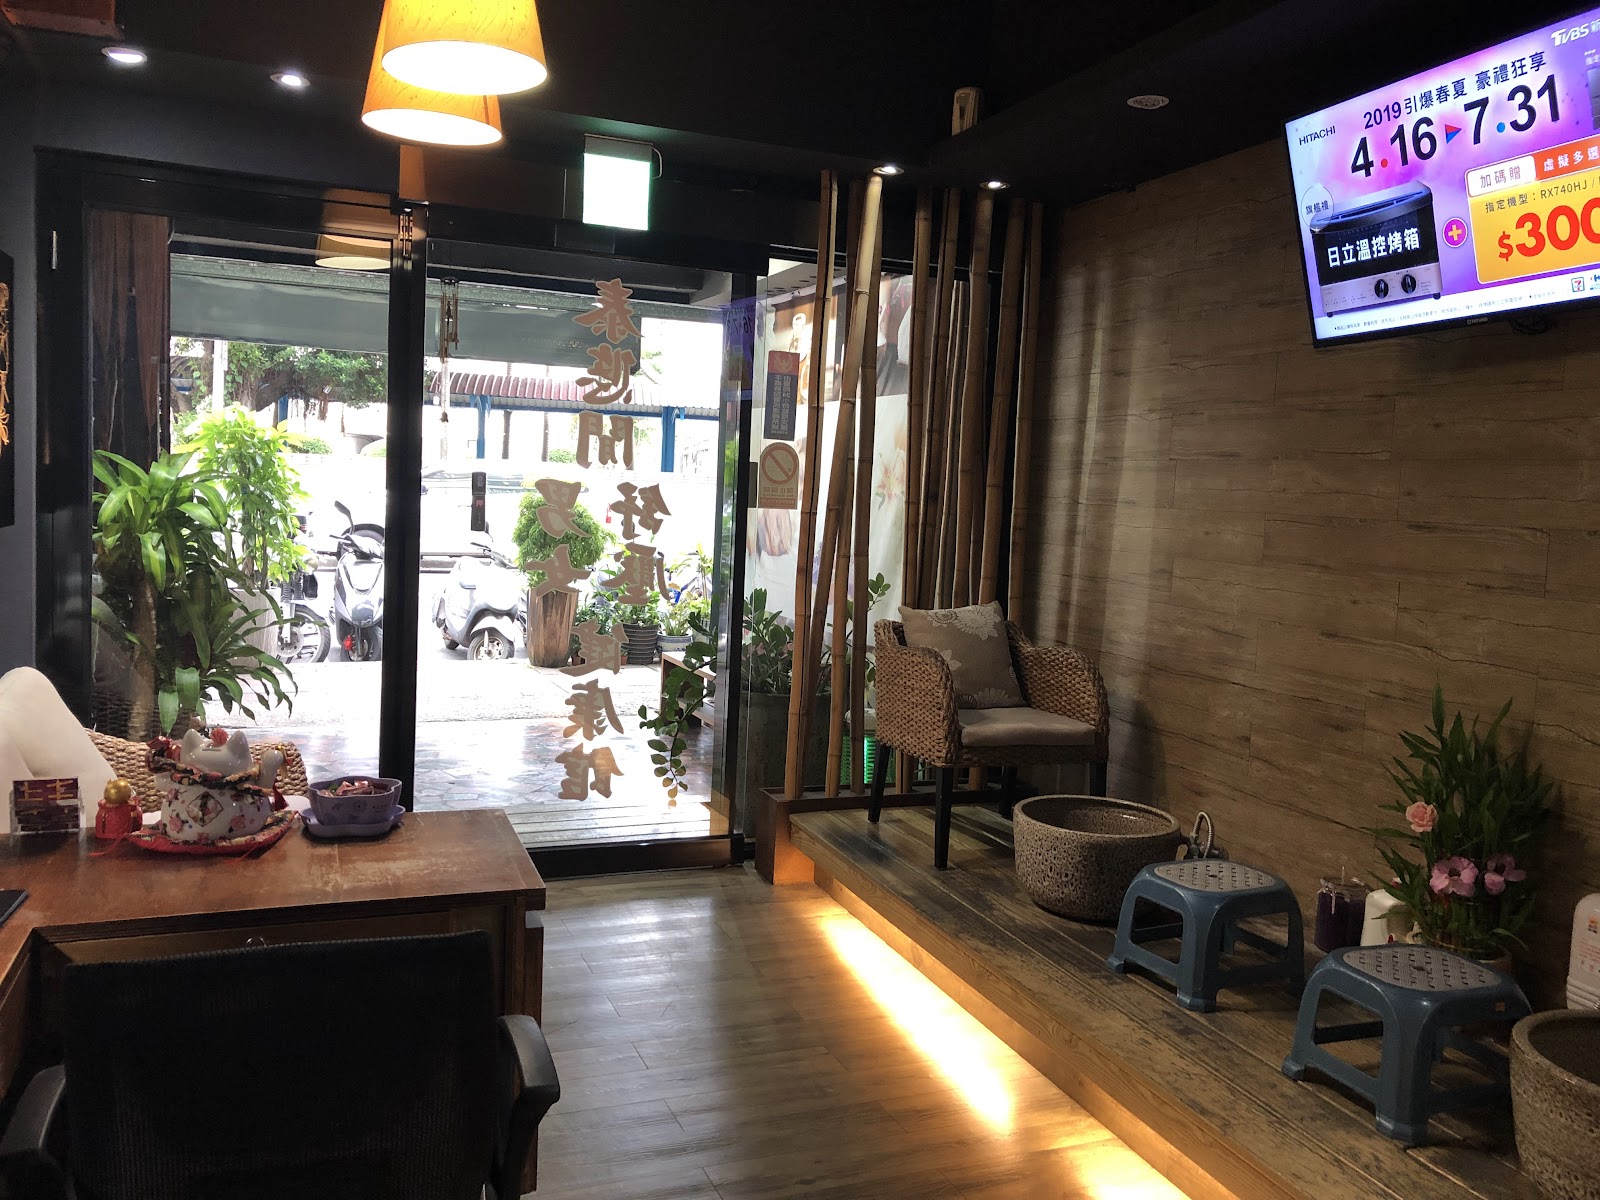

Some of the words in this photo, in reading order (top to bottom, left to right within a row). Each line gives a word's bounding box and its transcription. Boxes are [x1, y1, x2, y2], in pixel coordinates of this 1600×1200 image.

[1551, 23, 1589, 46] TVBS
[1475, 51, 1546, 91] 豪禮狂享
[1299, 126, 1336, 145] HITACHI
[1351, 116, 1437, 177] 4.16
[1464, 74, 1560, 145] 7.31
[1544, 146, 1600, 172] 虛擬多選
[1480, 165, 1521, 188] 加碼贈
[1540, 180, 1588, 199] RX740HJ
[1327, 227, 1420, 268] 日立溫控烤箱
